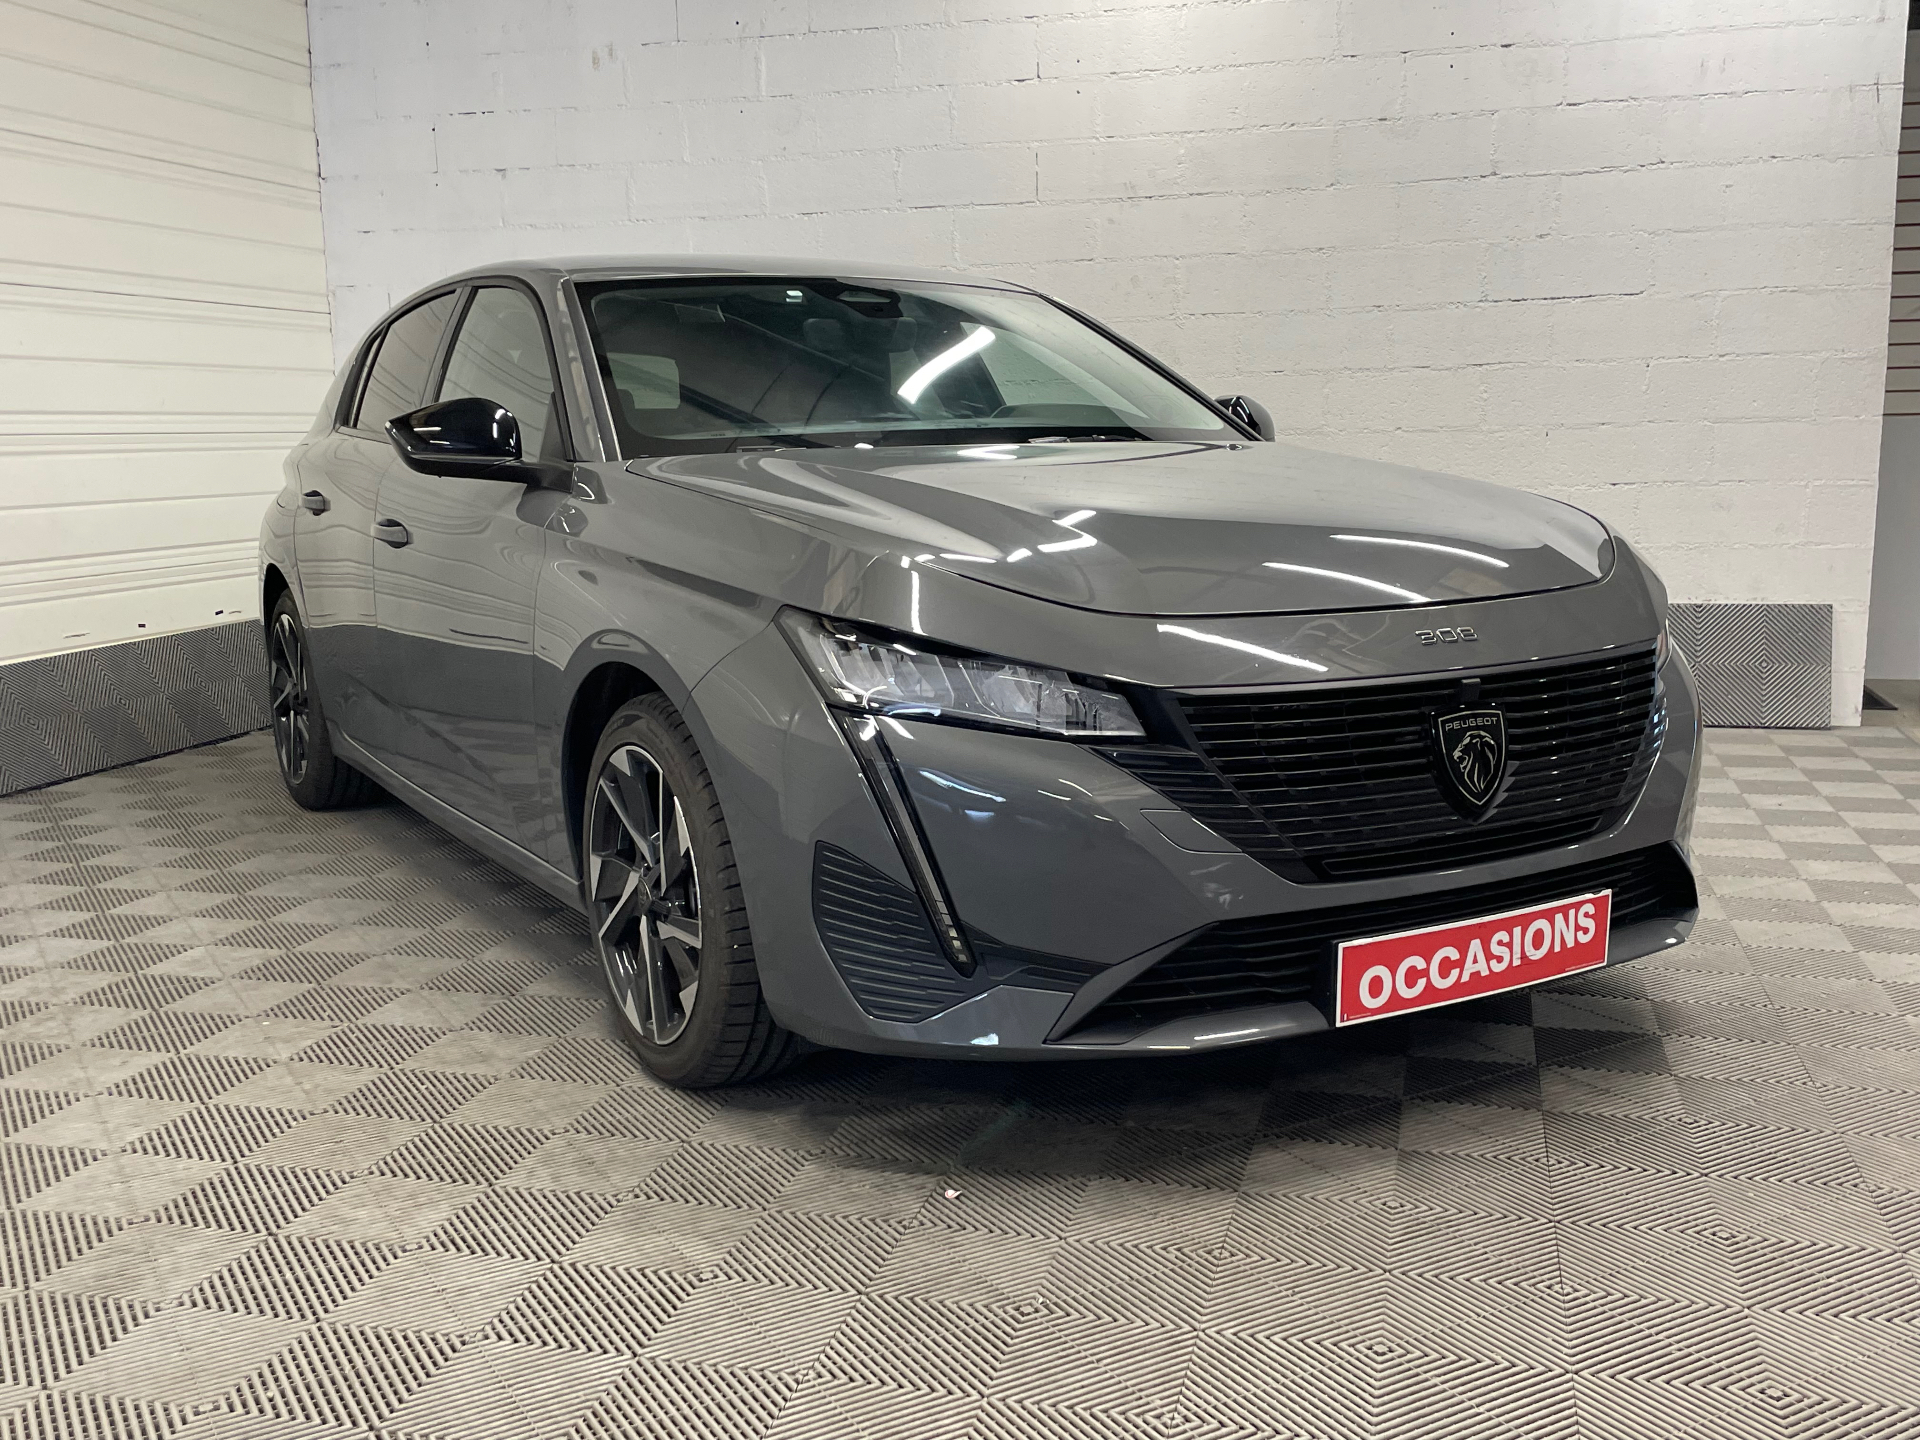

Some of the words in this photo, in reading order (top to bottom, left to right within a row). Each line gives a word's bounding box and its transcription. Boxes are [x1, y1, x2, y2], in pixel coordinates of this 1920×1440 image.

[1415, 626, 1478, 646] 308
[1445, 717, 1498, 731] PEUGEOT
[1359, 903, 1596, 1009] OCCASIONS
